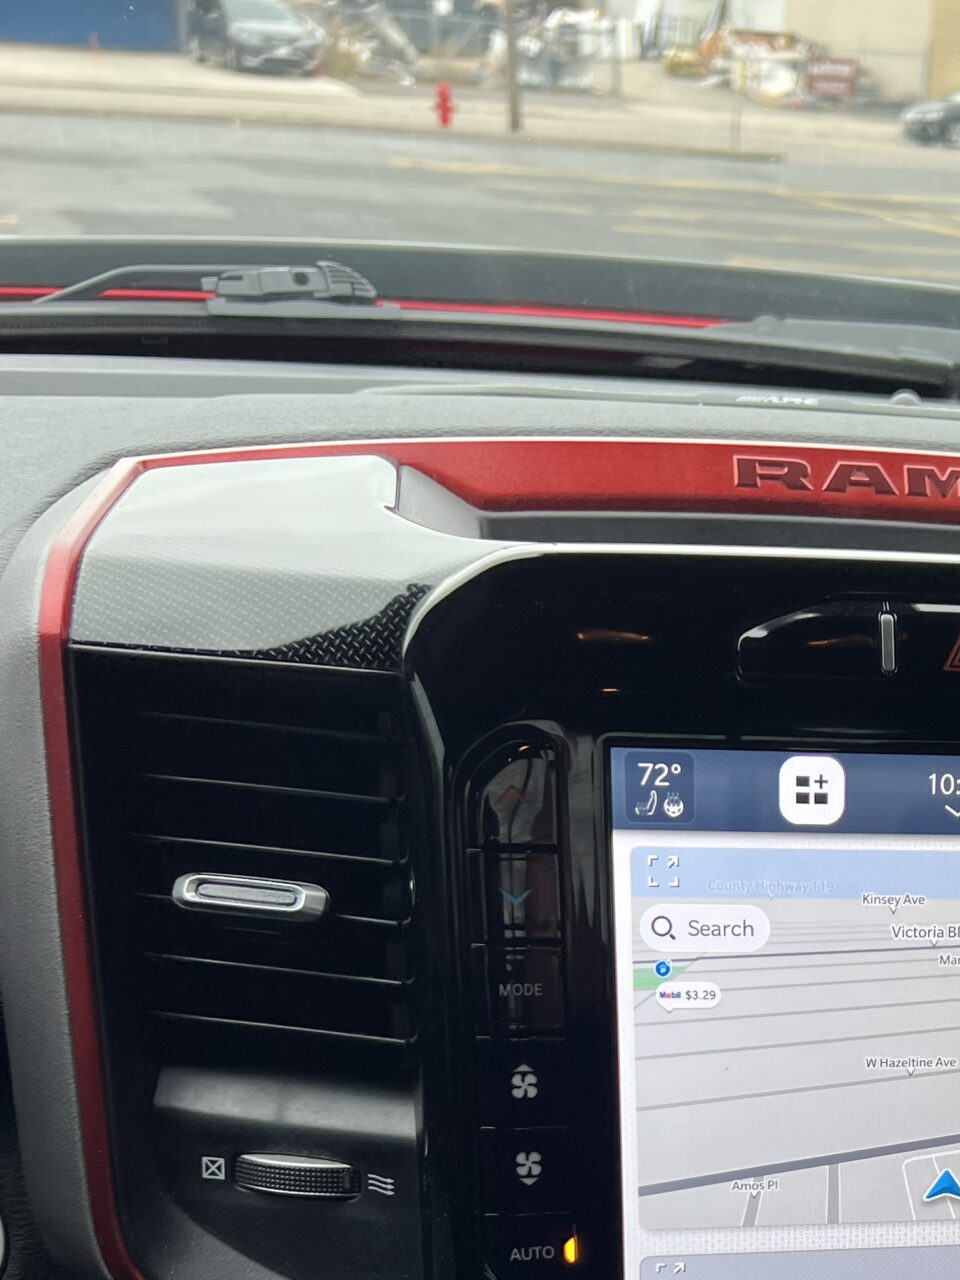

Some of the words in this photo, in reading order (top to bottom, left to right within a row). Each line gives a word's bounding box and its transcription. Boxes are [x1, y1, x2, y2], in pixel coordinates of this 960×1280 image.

[861, 894, 901, 908] Kinsey
[903, 894, 925, 906] Ave
[688, 919, 754, 939] Search
[892, 925, 944, 940] Victoria
[499, 984, 543, 997] MODE
[685, 988, 716, 1002] $3.29
[866, 1057, 877, 1069] W
[879, 1056, 933, 1069] Hazeltine
[935, 1055, 957, 1068] Ave
[732, 1180, 765, 1193] Amos
[510, 1246, 555, 1261] AUTO
